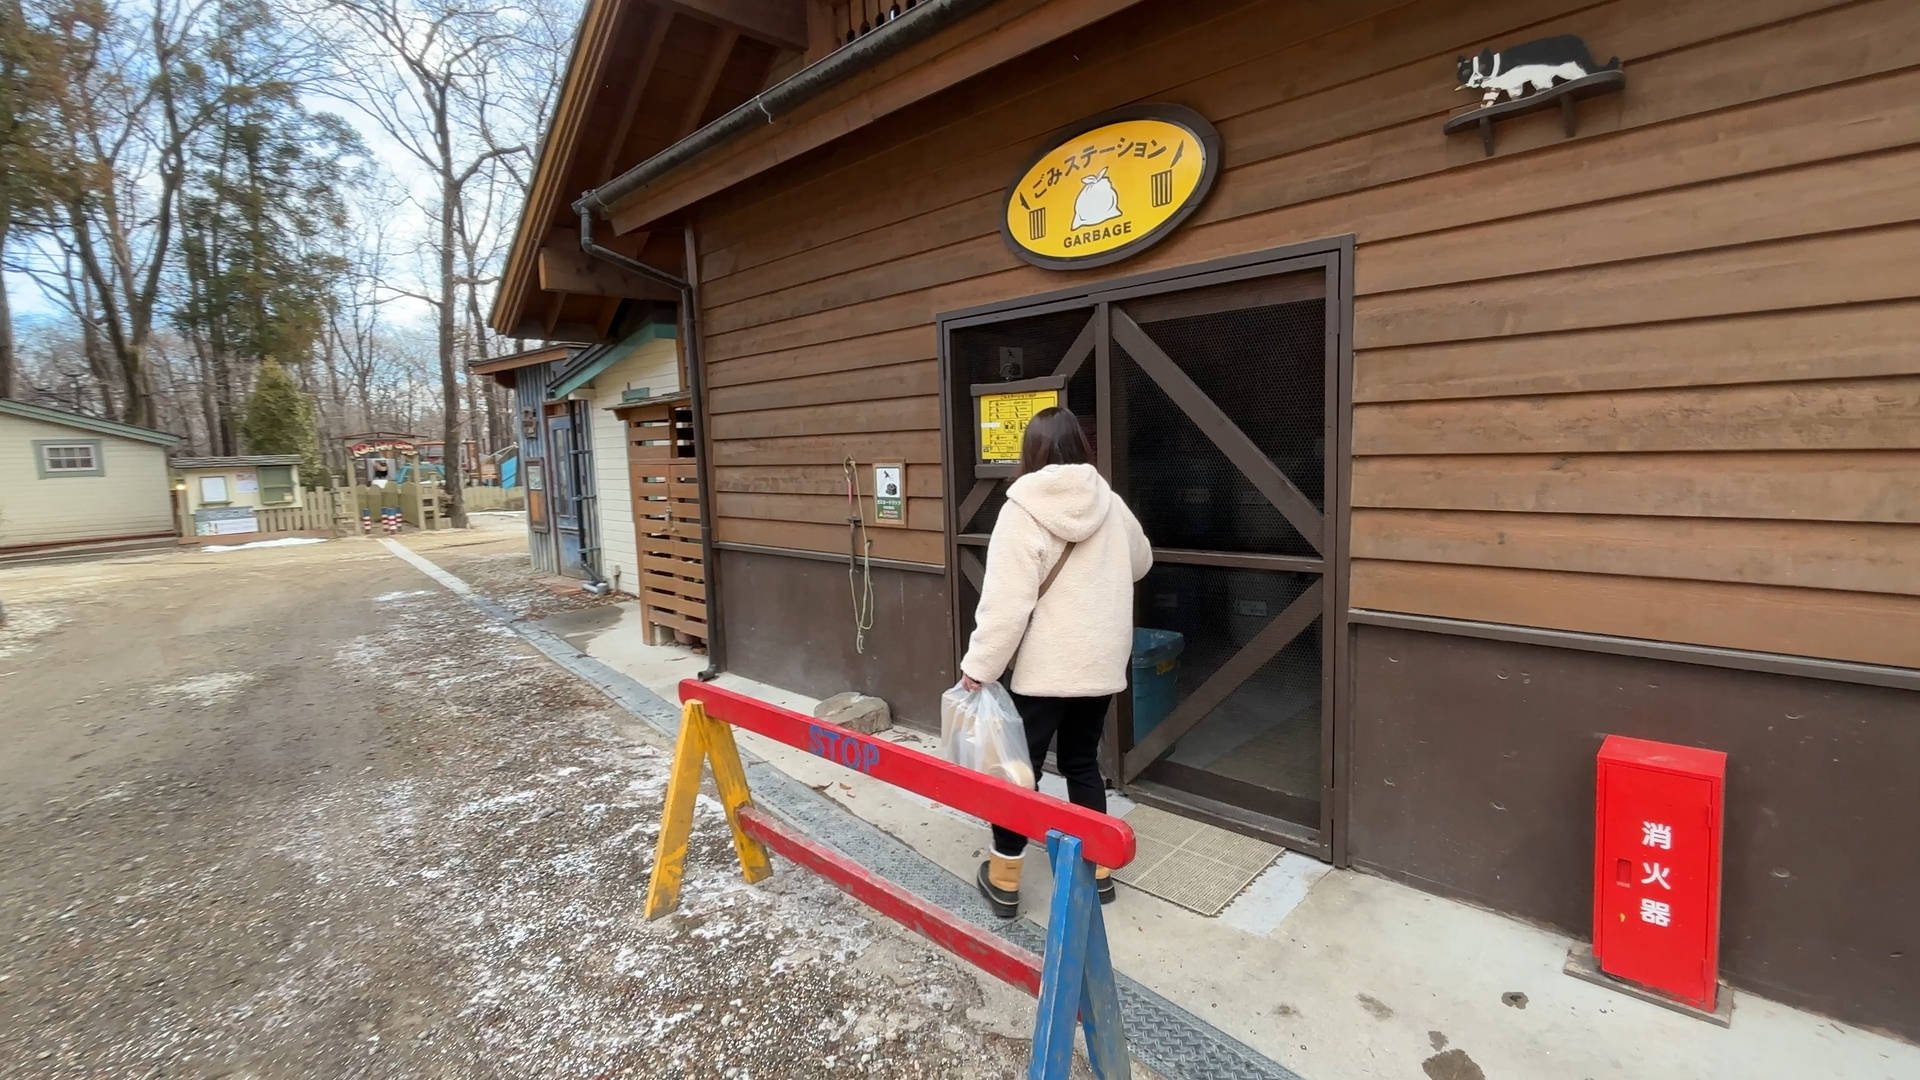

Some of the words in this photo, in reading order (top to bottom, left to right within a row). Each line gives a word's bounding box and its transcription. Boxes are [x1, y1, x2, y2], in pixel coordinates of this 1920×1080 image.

[1032, 137, 1167, 199] ごみステーション
[1063, 221, 1132, 249] GARBAGE
[809, 724, 880, 774] STOP
[1640, 821, 1672, 927] 消火器
